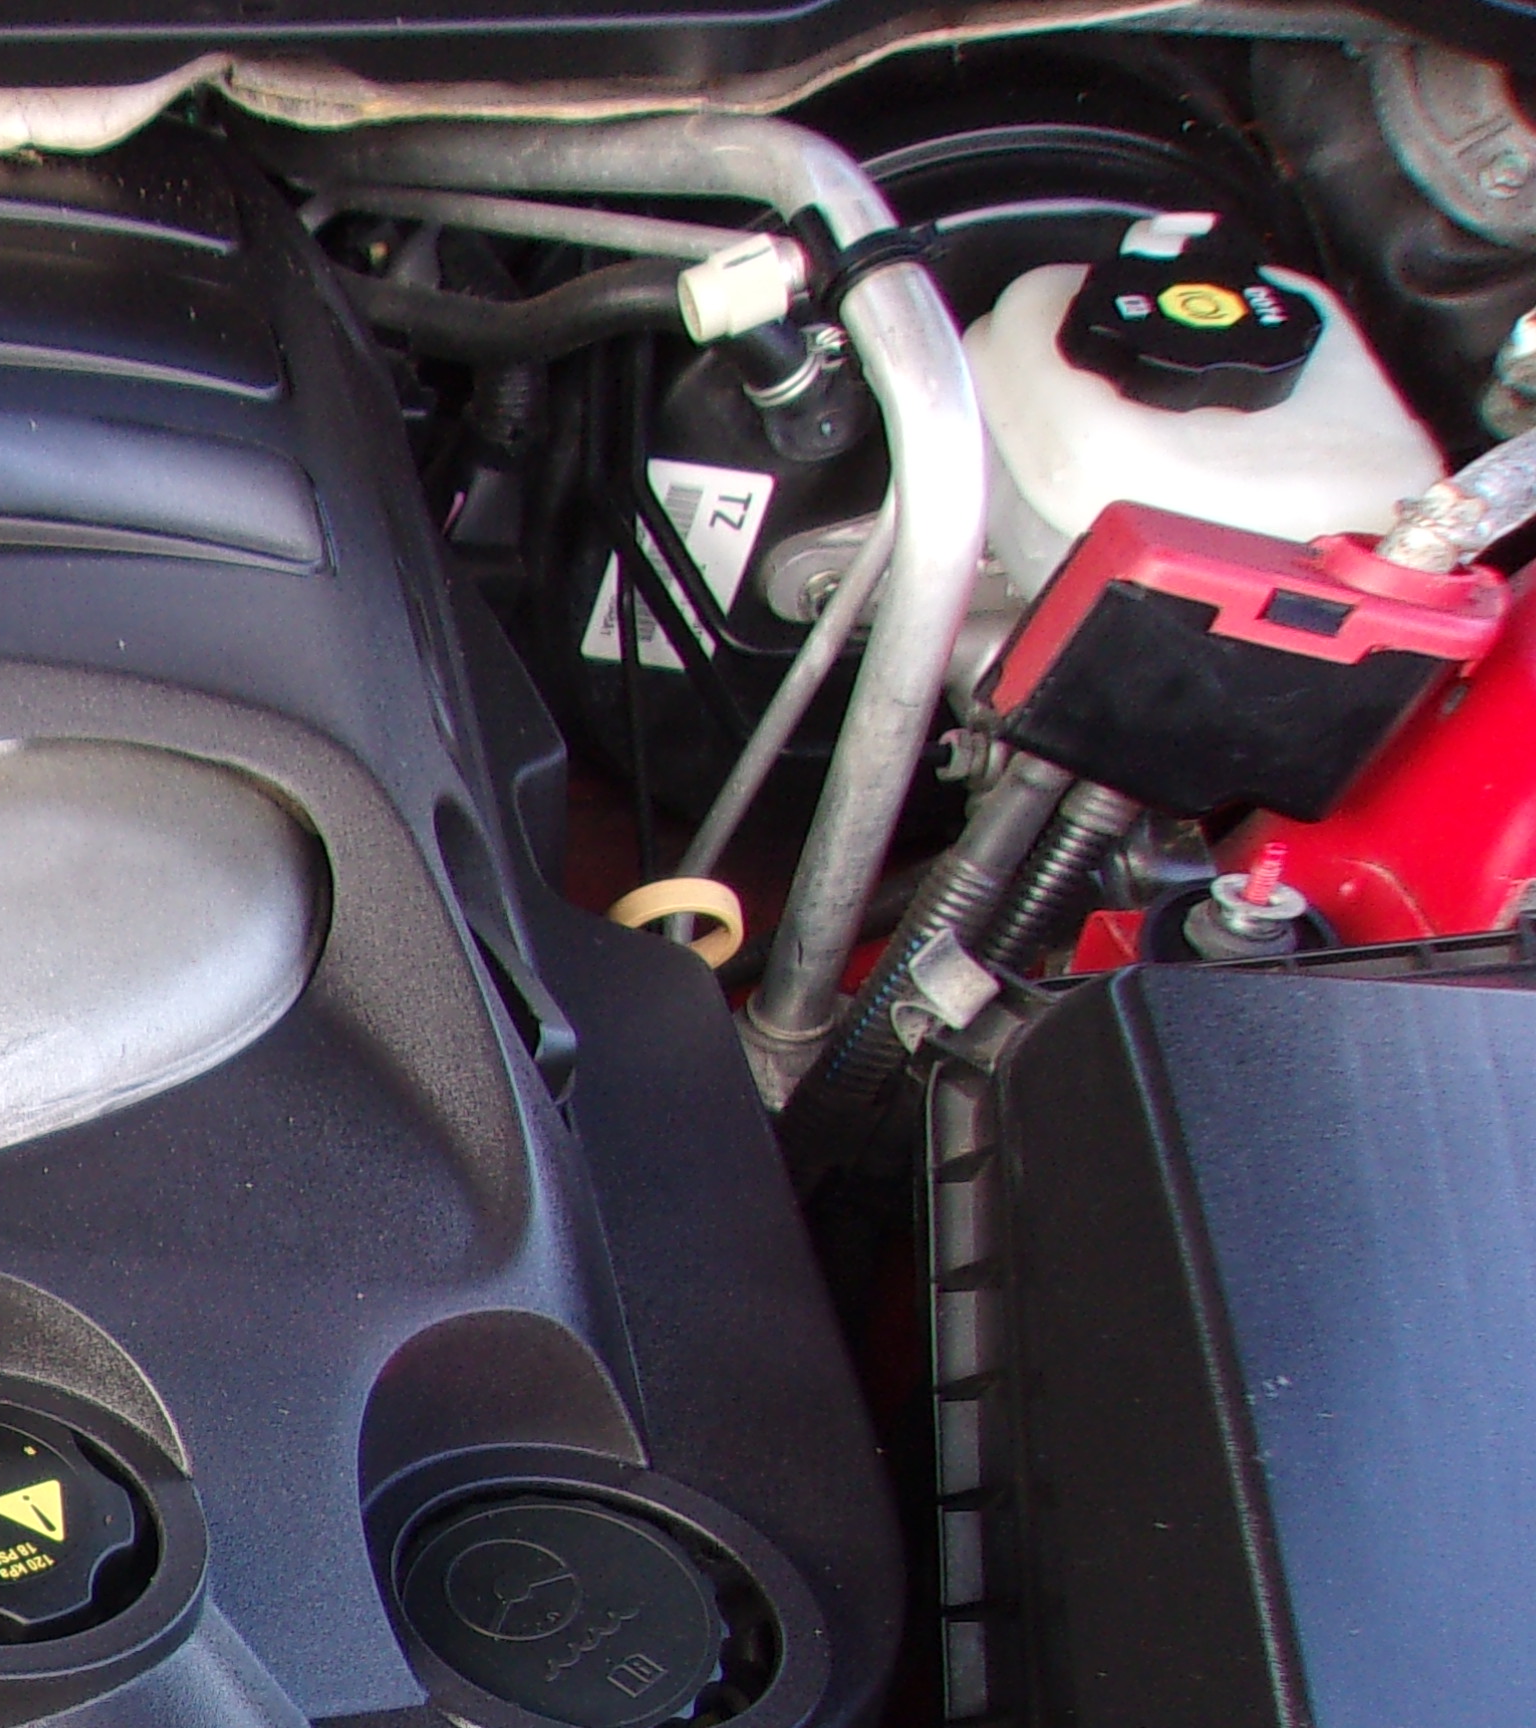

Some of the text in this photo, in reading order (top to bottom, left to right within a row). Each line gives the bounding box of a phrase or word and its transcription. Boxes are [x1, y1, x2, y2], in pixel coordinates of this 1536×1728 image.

[709, 492, 752, 530] TZ
[17, 1542, 37, 1556] 18
[27, 1554, 55, 1571] 120
